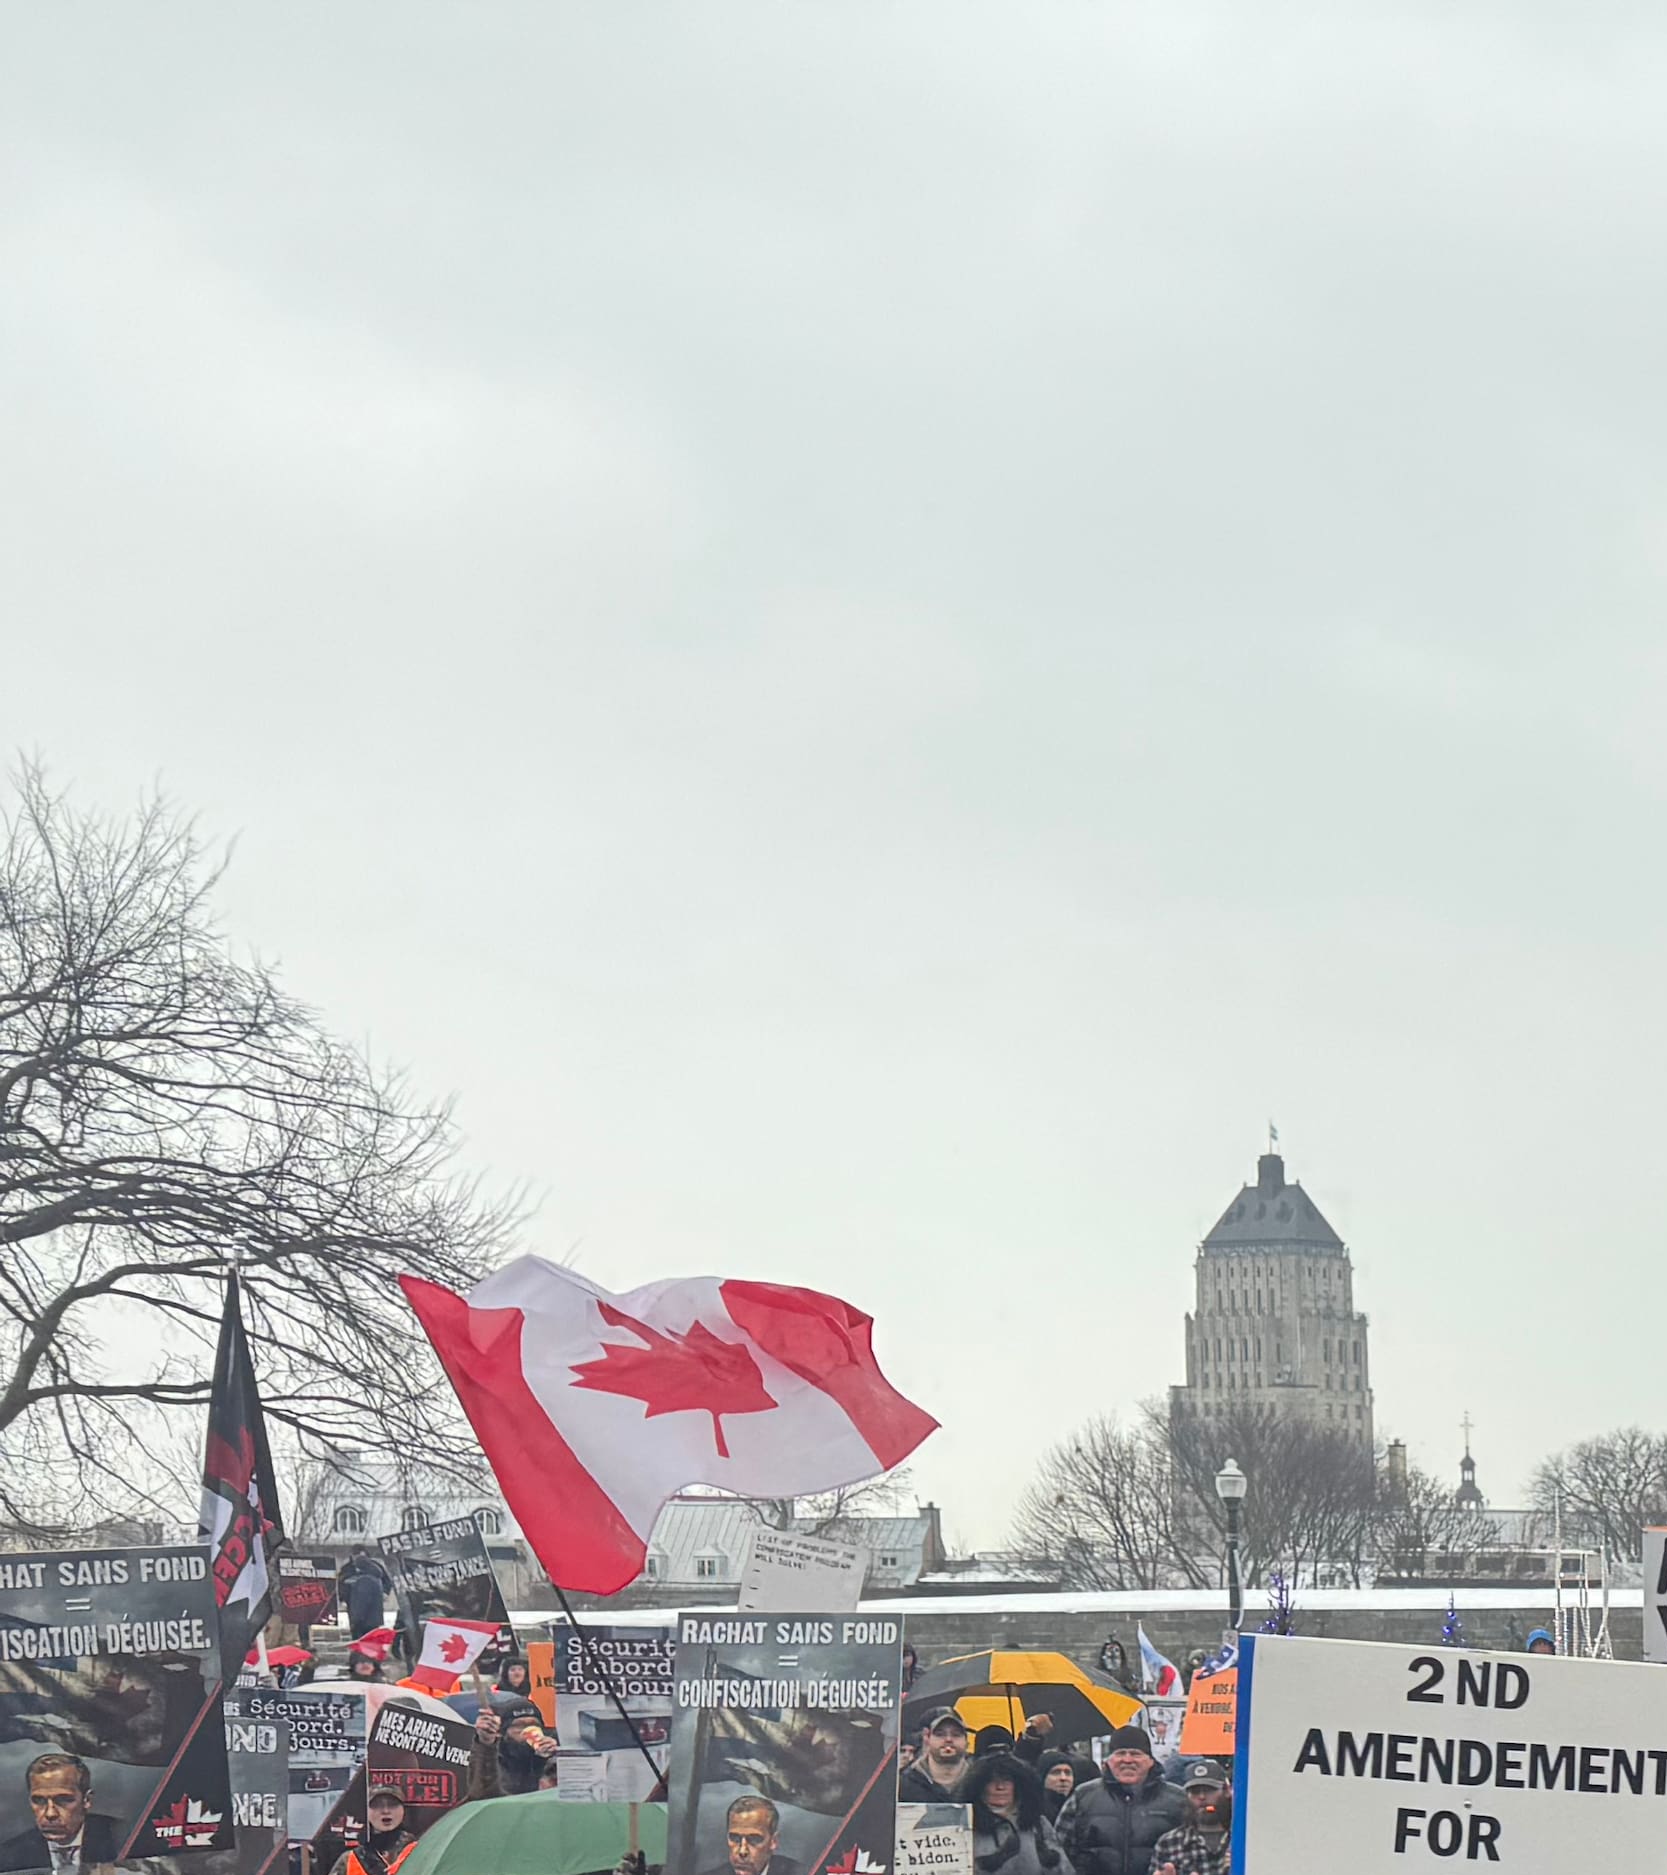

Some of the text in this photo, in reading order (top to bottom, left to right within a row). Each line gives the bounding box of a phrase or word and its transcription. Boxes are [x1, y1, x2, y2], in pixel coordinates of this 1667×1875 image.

[59, 1556, 206, 1586] SANS FOND
[107, 1609, 212, 1657] DÉGUISÉE.
[682, 1619, 897, 1645] RACHAT SANS FOND
[250, 1696, 351, 1719] Sécurité
[679, 1671, 895, 1712] CONFISCATION DÉGUISÉE.
[1393, 1807, 1502, 1862] FOR
